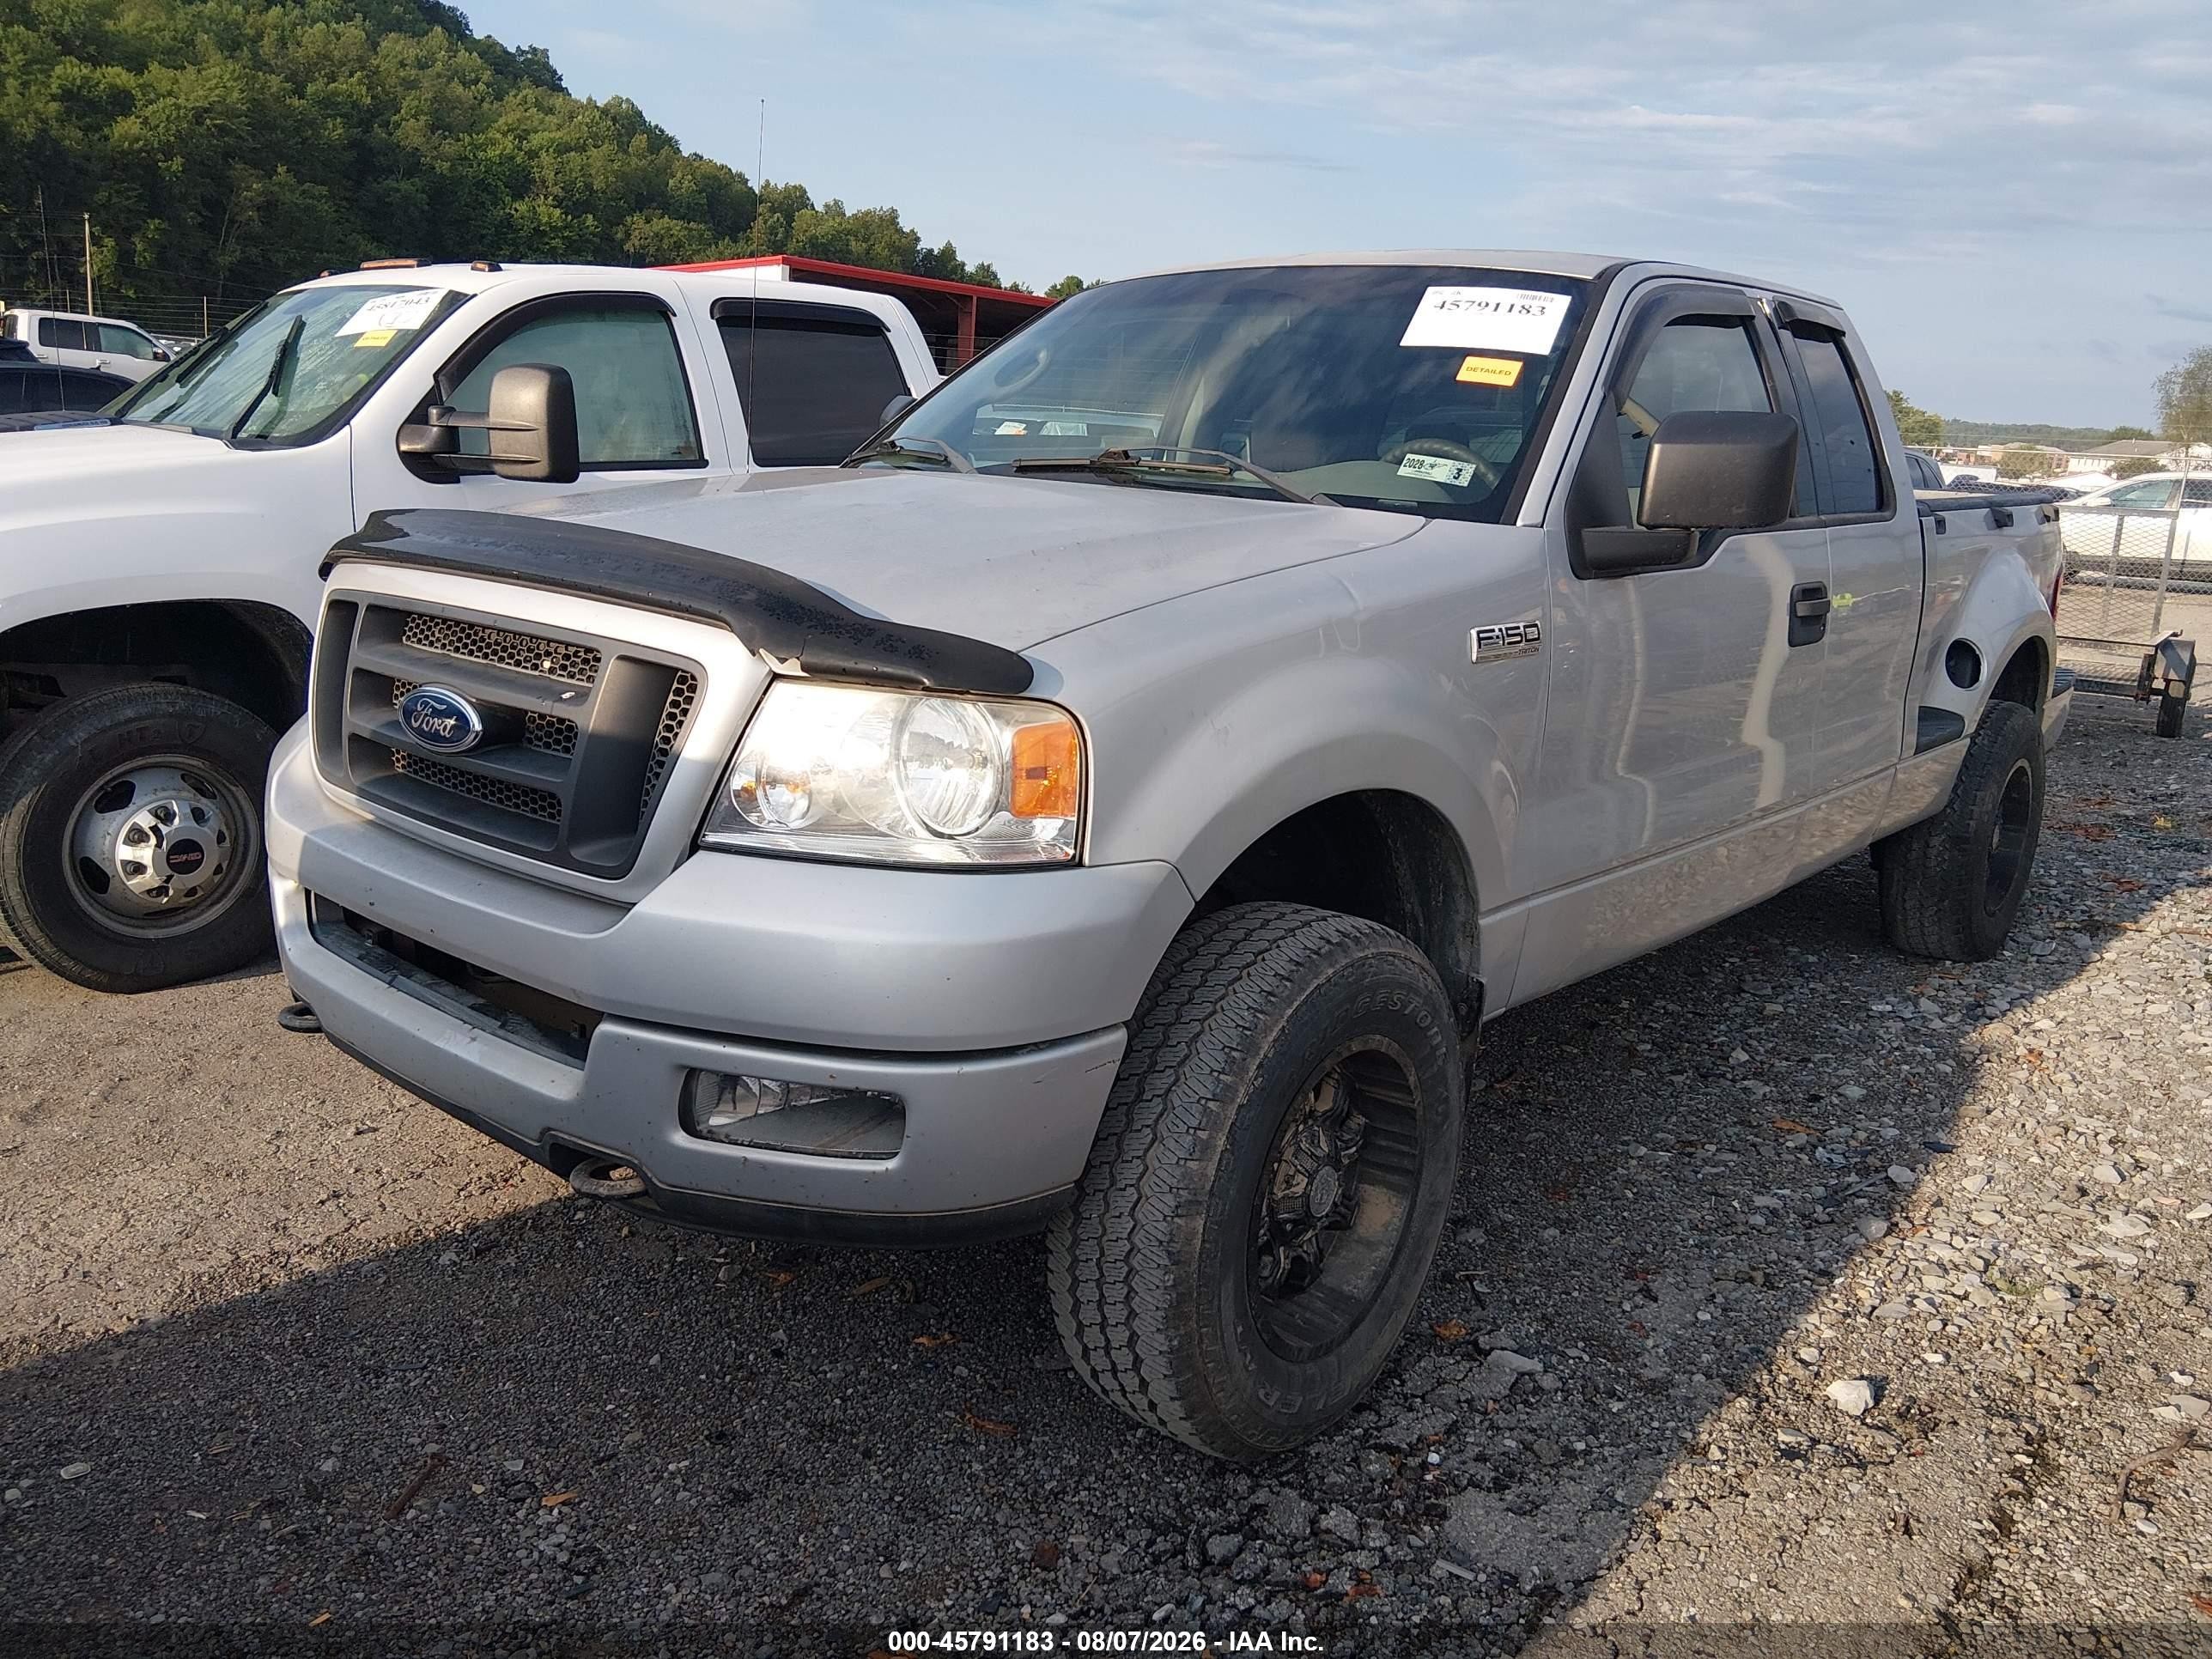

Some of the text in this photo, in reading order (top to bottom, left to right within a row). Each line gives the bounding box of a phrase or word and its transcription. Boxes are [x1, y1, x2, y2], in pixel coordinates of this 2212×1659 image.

[1433, 300, 1547, 316] 45791183
[1465, 365, 1512, 378] DETAILED
[1403, 458, 1425, 470] 2028
[1452, 468, 1463, 480] 3
[1517, 647, 1540, 655] TRITON
[411, 697, 457, 738] Ford
